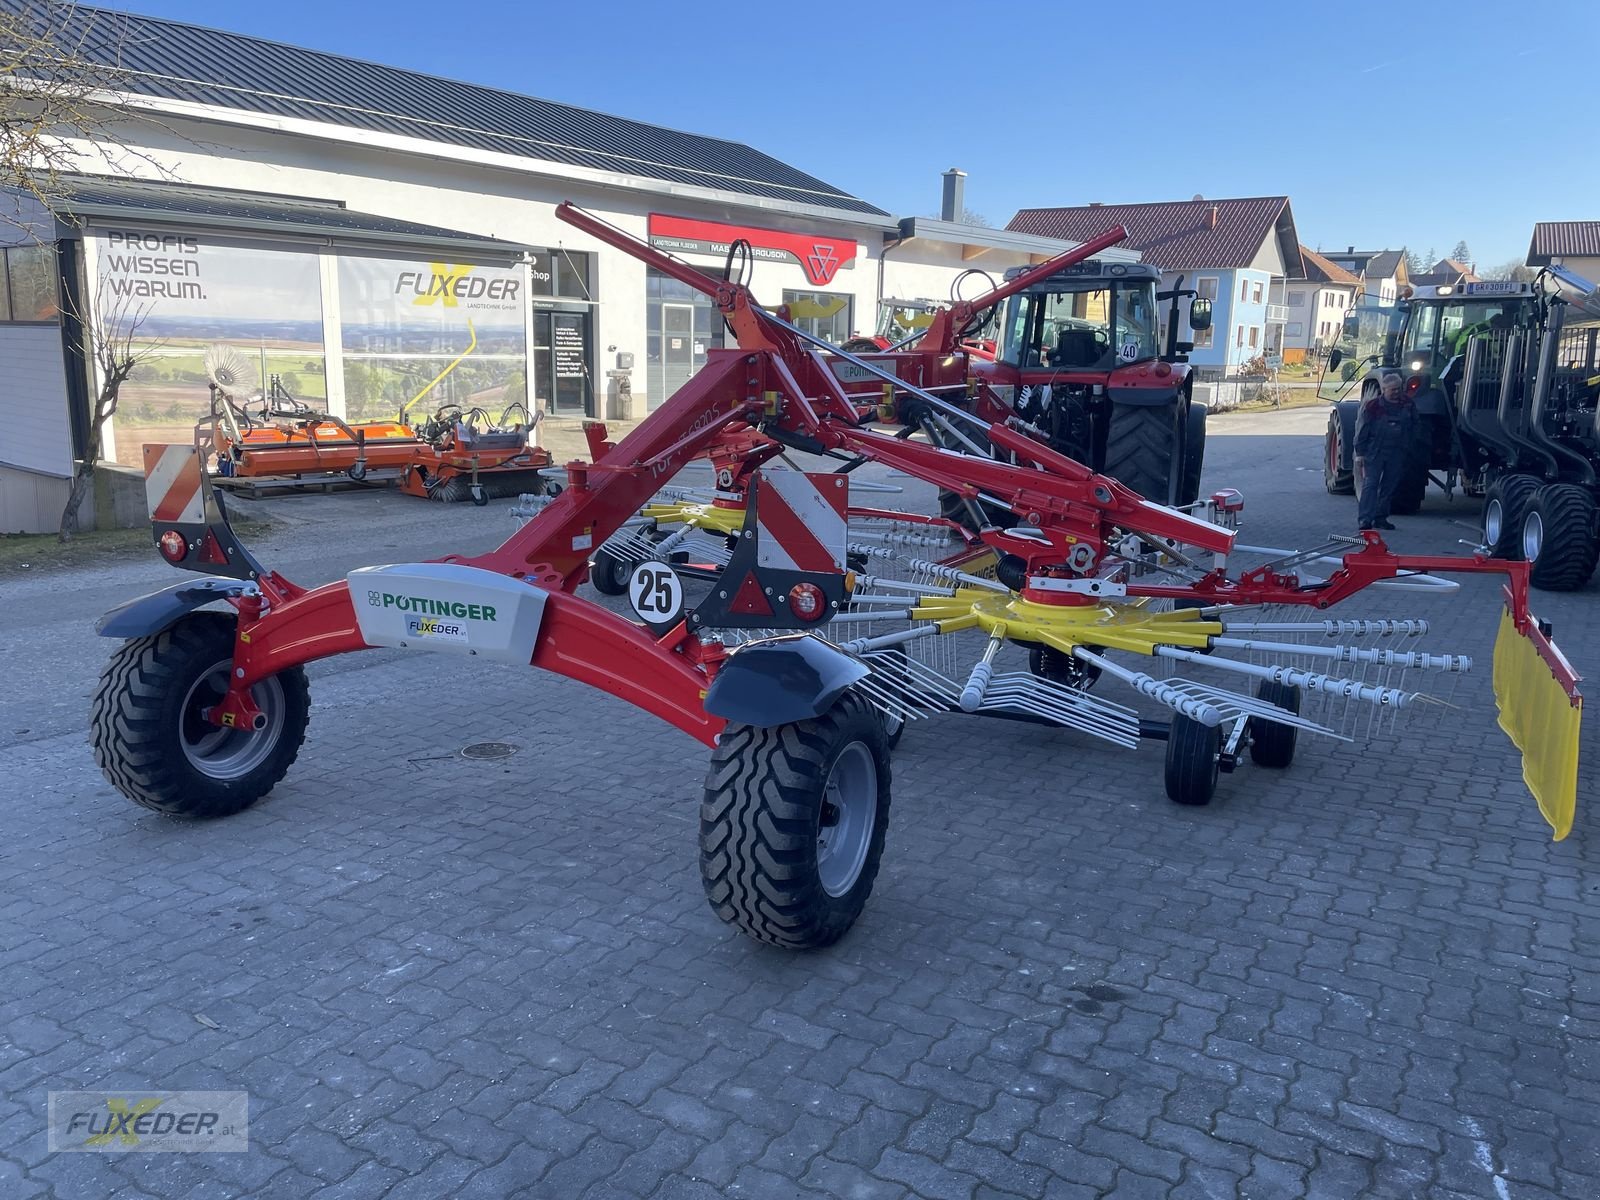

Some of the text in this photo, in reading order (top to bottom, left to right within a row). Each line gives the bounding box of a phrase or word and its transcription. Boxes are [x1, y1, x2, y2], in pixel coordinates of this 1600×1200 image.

[108, 231, 199, 254] PROFIS
[395, 271, 520, 301] FLIXEDER
[467, 302, 500, 310] LANDTECHNIK
[1122, 345, 1136, 358] 40
[637, 568, 672, 614] 25
[382, 592, 497, 622] PÖTTINGER
[409, 621, 459, 635] FLIXEDER
